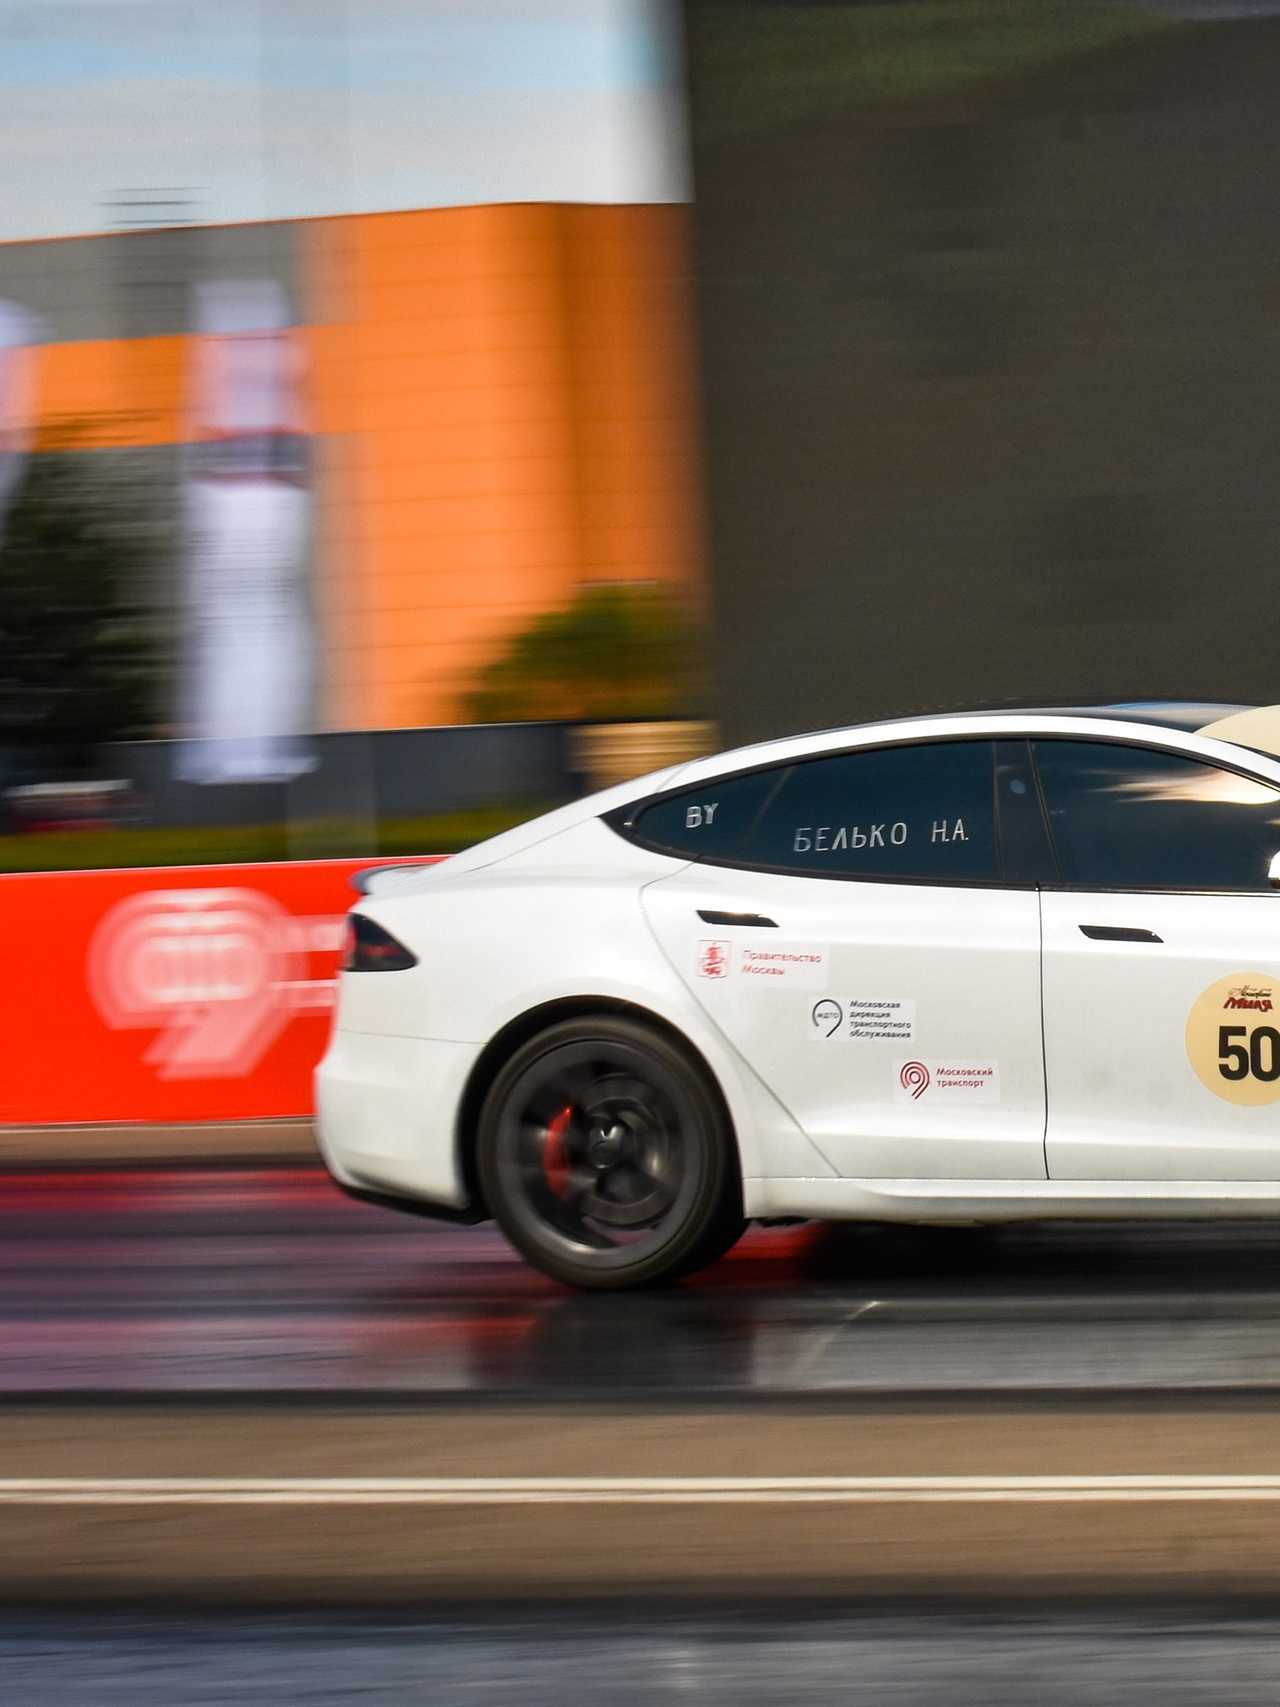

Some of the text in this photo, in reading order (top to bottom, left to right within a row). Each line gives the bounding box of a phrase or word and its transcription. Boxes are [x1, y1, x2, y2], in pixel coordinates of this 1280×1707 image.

[793, 818, 969, 852] БЕЛЬКО Н.А.
[849, 1000, 901, 1009] Московская
[849, 1011, 891, 1019] дирекция
[849, 1021, 912, 1030] транспортного
[849, 1029, 912, 1039] обслуживания
[936, 1067, 994, 1076] Московский
[937, 1079, 984, 1089] транспорт
